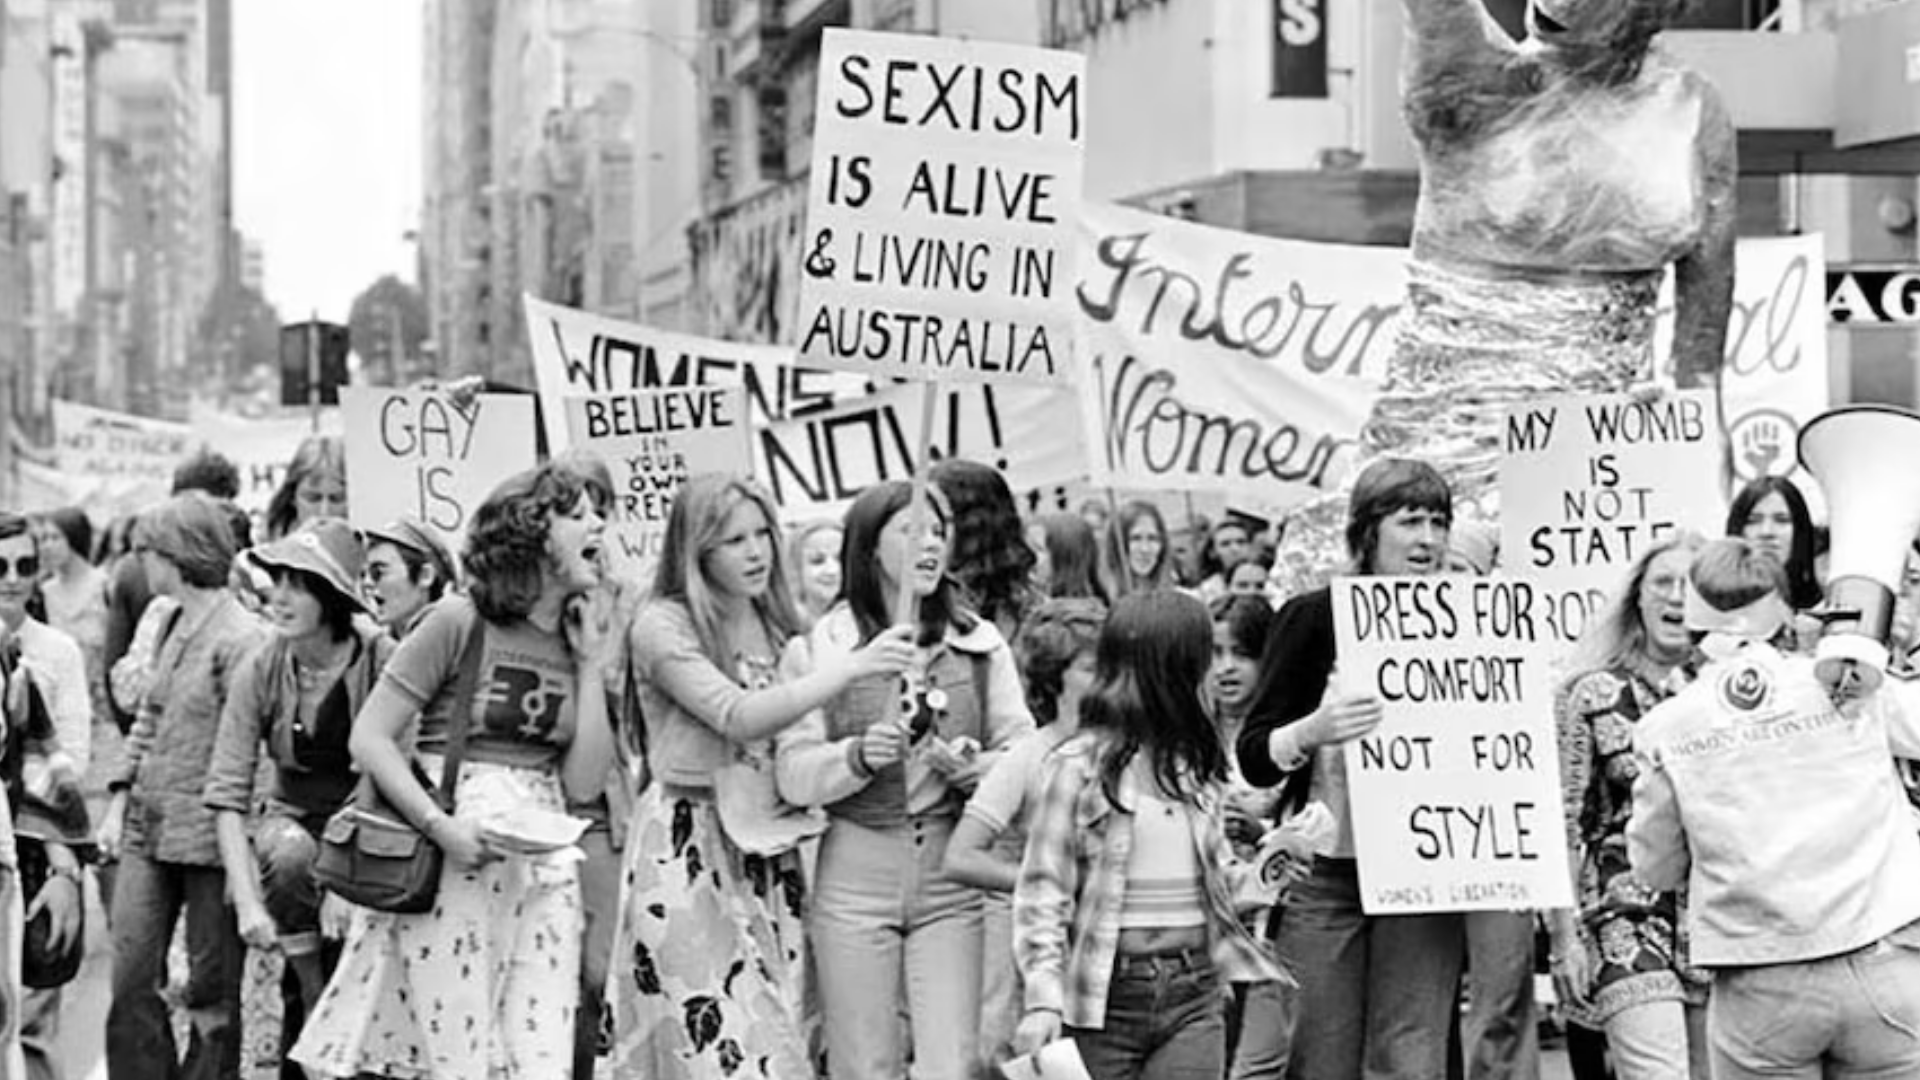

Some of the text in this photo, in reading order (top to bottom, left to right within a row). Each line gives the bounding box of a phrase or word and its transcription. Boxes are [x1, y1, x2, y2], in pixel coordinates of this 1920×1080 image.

[836, 54, 1078, 140] SEXISM
[828, 155, 1057, 224] IS ALIVE
[805, 228, 1053, 298] & LIVING IN
[1828, 273, 1920, 322] AG
[801, 305, 1054, 375] AUSTRALIA
[380, 394, 481, 460] GAY
[586, 390, 733, 438] BELIEVE
[1508, 400, 1704, 454] MY WOMB
[624, 453, 687, 473] YOUR
[642, 437, 668, 452] IN
[1590, 454, 1620, 487] IS
[418, 466, 463, 532] IS
[1565, 488, 1654, 521] NOT
[1351, 581, 1536, 642] DRESS FOR
[1378, 655, 1524, 703] COMFORT
[1361, 731, 1535, 771] NOT FOR
[1410, 802, 1538, 860] STYLE
